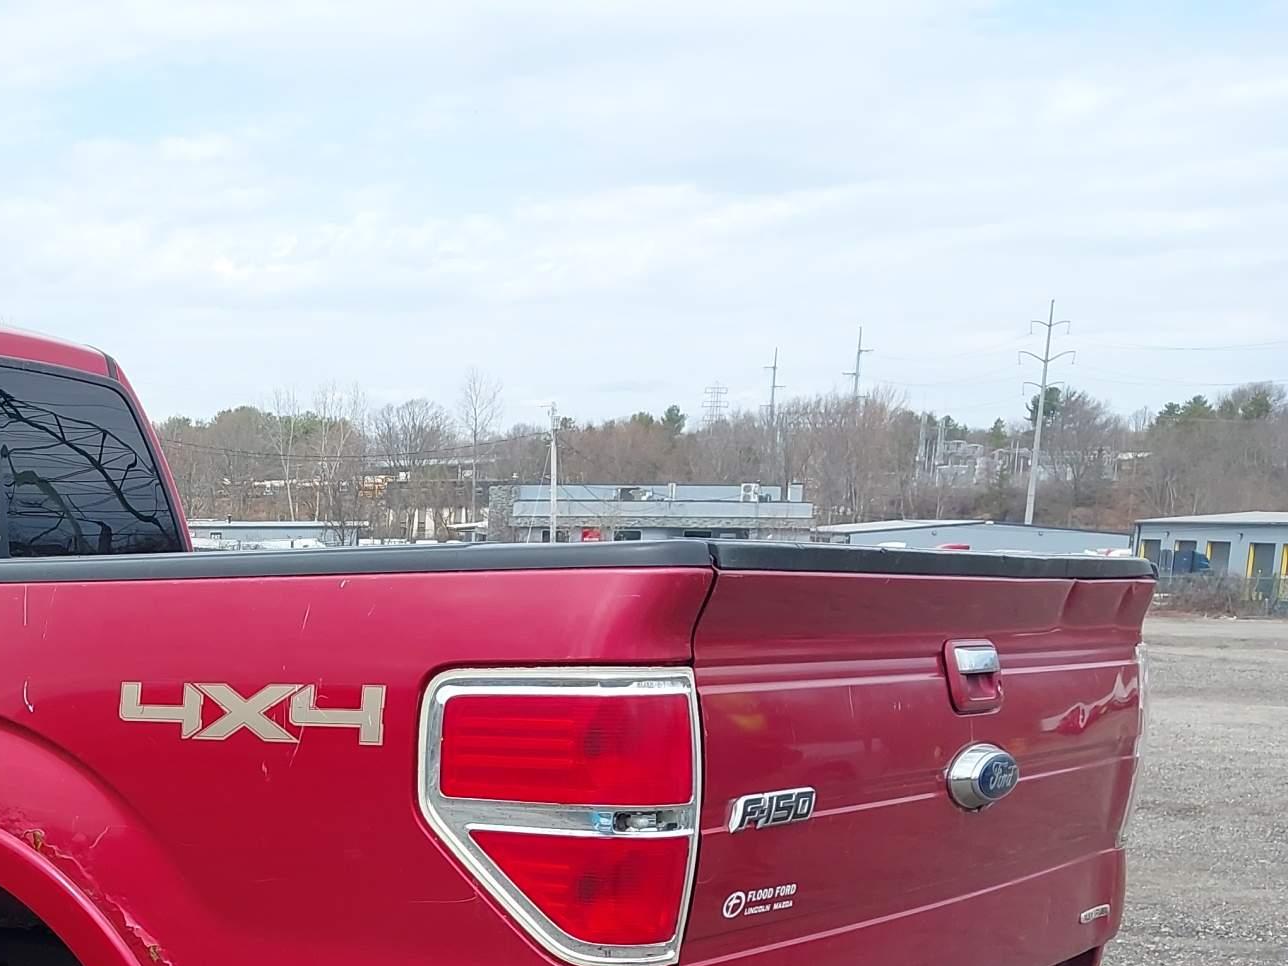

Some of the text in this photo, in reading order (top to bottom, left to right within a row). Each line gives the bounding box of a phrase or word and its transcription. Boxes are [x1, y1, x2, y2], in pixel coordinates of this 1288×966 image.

[989, 761, 1017, 790] Ford
[731, 787, 816, 832] F-150
[747, 883, 797, 902] FLOOD FORD
[744, 900, 793, 916] LINCOLN MAZDA
